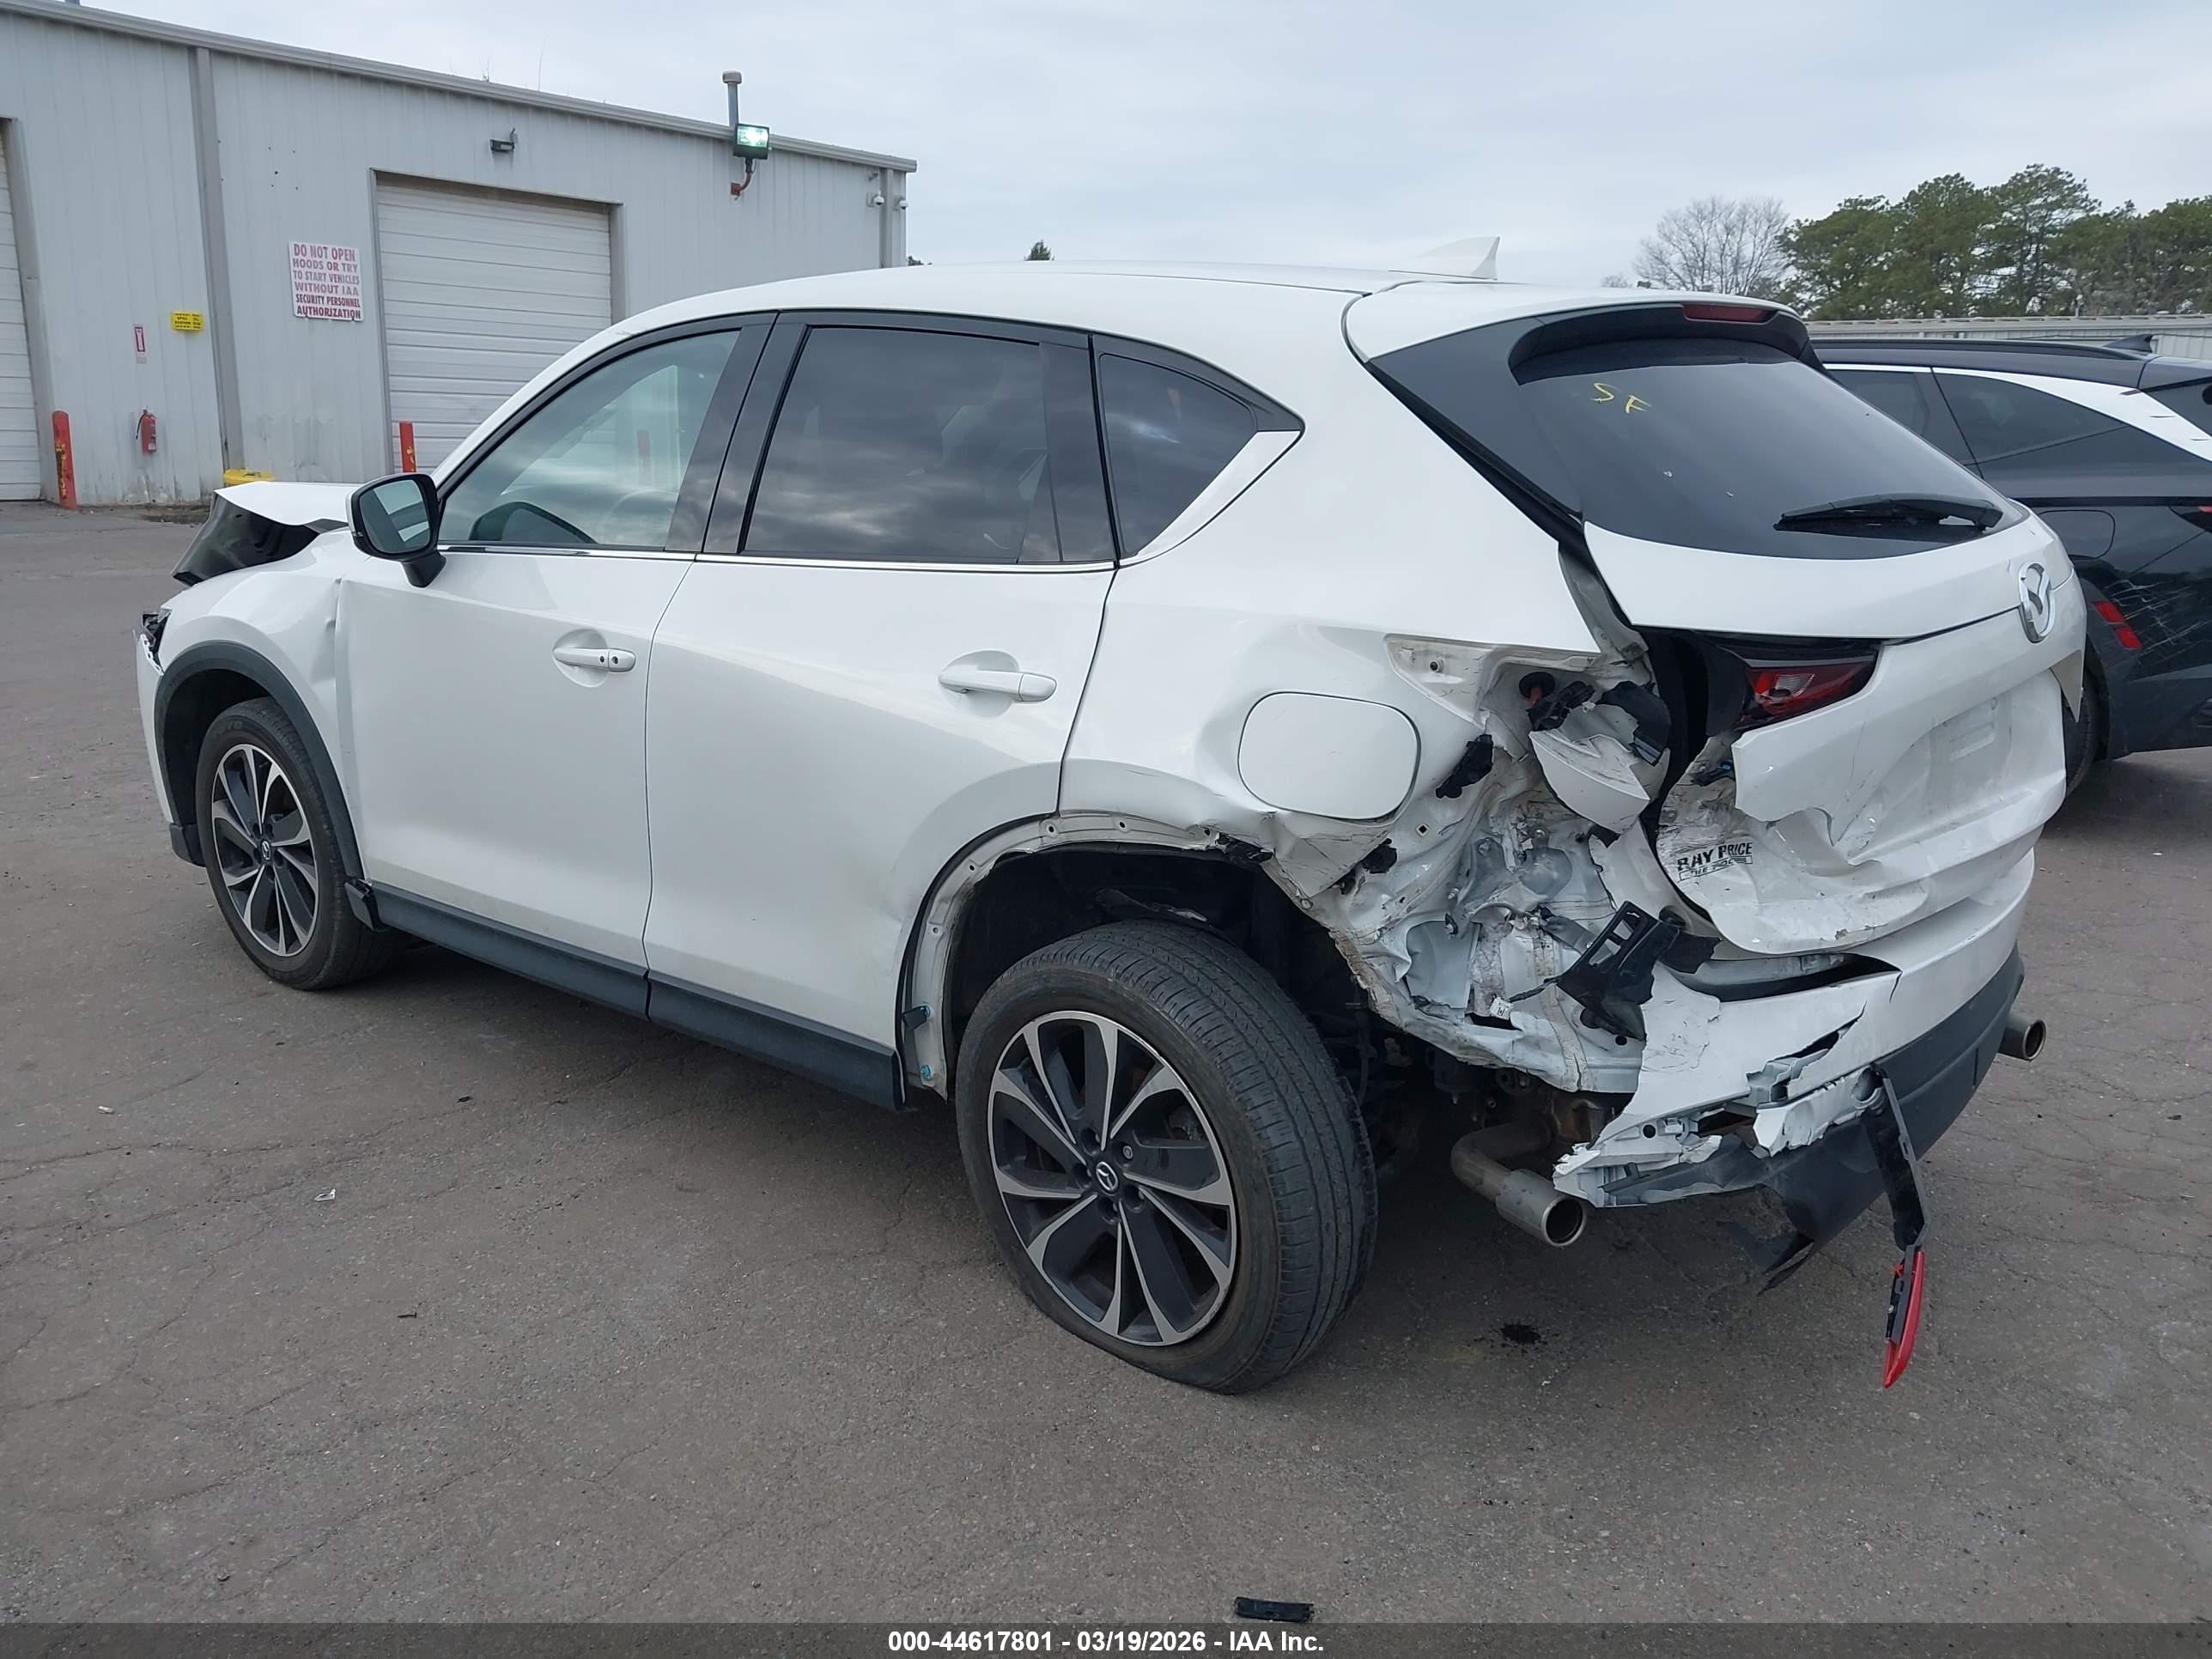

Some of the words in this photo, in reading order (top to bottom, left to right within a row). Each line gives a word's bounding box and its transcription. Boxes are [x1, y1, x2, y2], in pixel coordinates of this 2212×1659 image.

[294, 243, 307, 258] DO
[310, 245, 328, 259] NOT
[331, 247, 356, 262] OPEN
[293, 258, 324, 270] HOODS
[327, 261, 339, 271] OR
[342, 263, 358, 273] TRY
[293, 270, 303, 280] TO
[305, 271, 326, 283] START
[329, 274, 360, 285] VEHICLES
[295, 281, 338, 295] WITHOUT
[342, 285, 359, 296] IAA
[295, 294, 325, 305] SECURITY
[326, 296, 361, 308] PERSONNEL
[296, 306, 362, 319] AUTHORIZATION
[1718, 842, 1753, 859] PRICE
